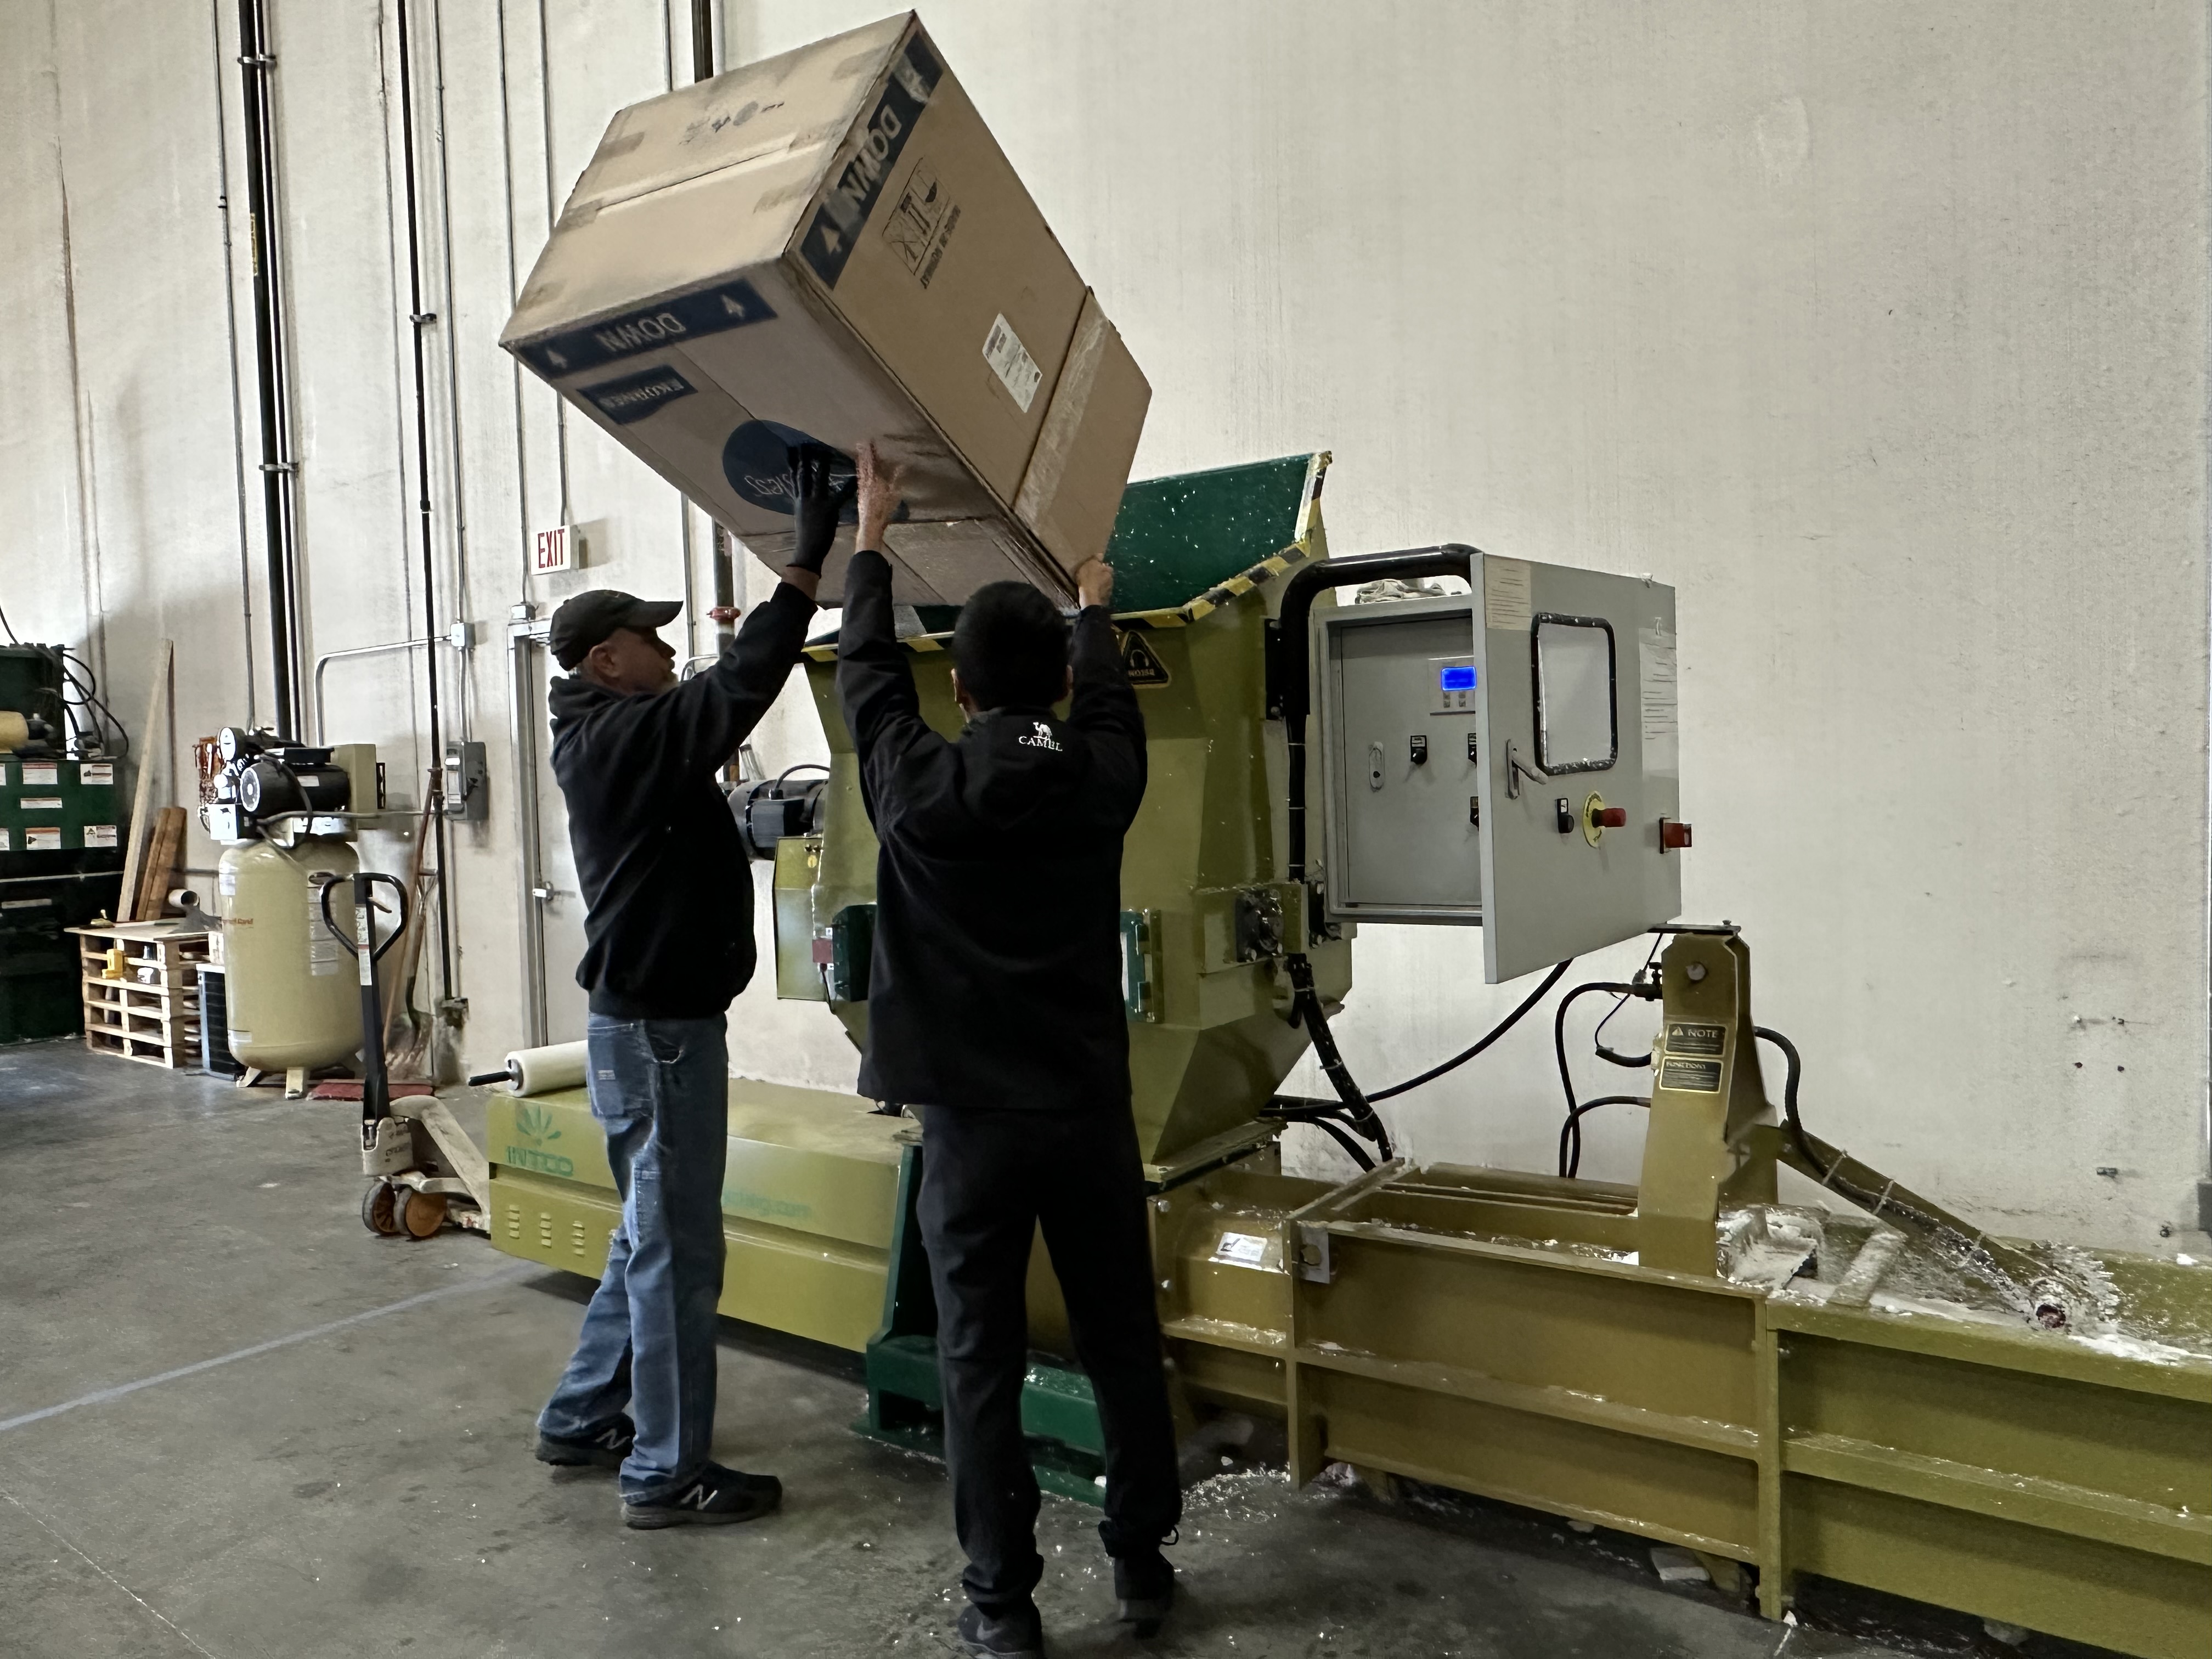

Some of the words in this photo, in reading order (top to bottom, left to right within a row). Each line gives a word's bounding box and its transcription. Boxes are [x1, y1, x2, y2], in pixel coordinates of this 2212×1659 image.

[595, 312, 687, 352] DOWN
[538, 528, 565, 568] EXIT
[1018, 736, 1063, 752] CAMEL
[1688, 1029, 1718, 1038] NOTE
